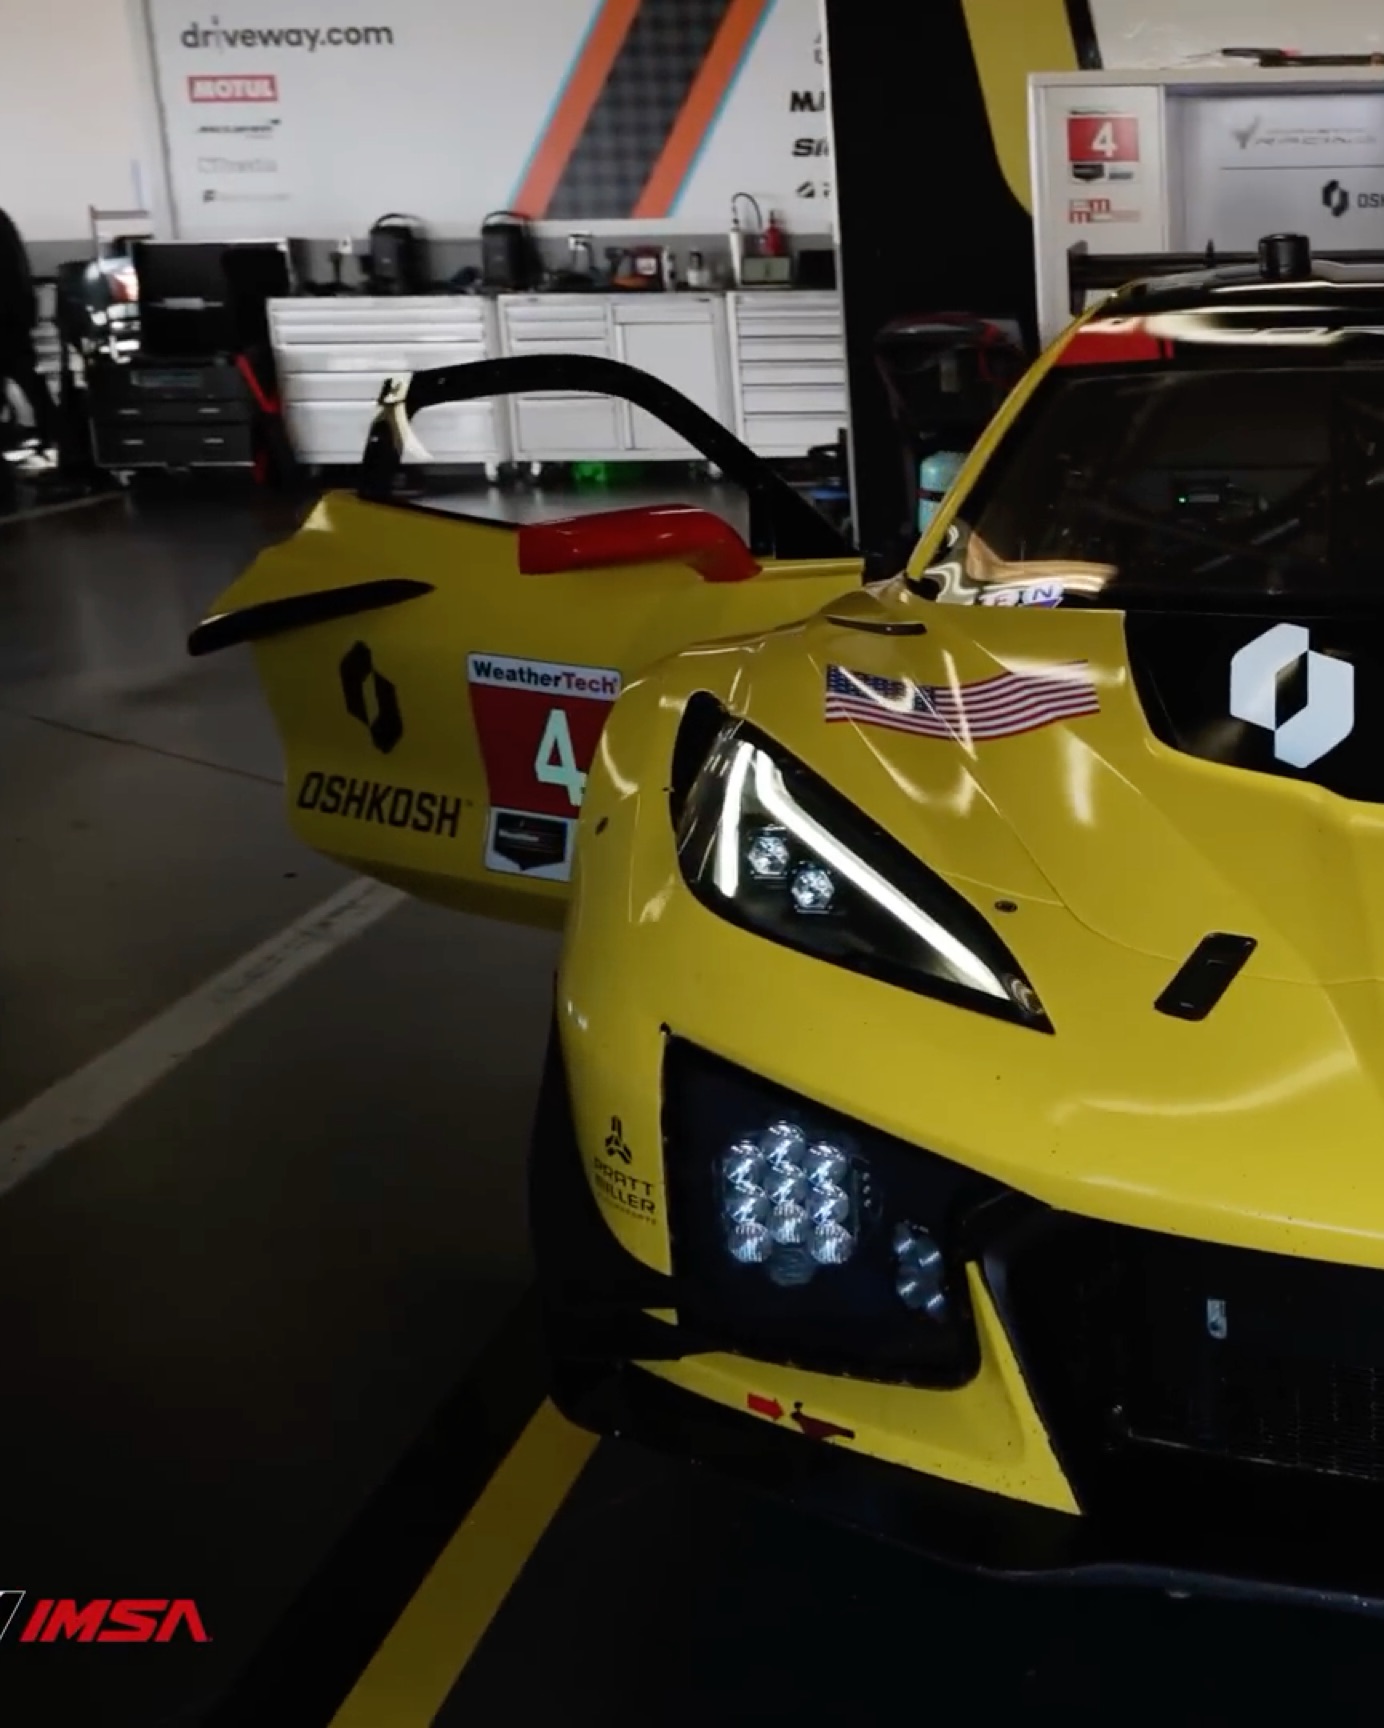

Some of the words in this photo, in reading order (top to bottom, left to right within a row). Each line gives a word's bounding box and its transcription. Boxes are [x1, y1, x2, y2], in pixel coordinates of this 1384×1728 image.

[180, 15, 394, 53] driveway.com
[193, 79, 274, 99] MOTUL
[1091, 121, 1118, 158] 4
[473, 660, 617, 695] WeatherTech
[535, 707, 587, 807] 4
[594, 1156, 655, 1196] PRATT
